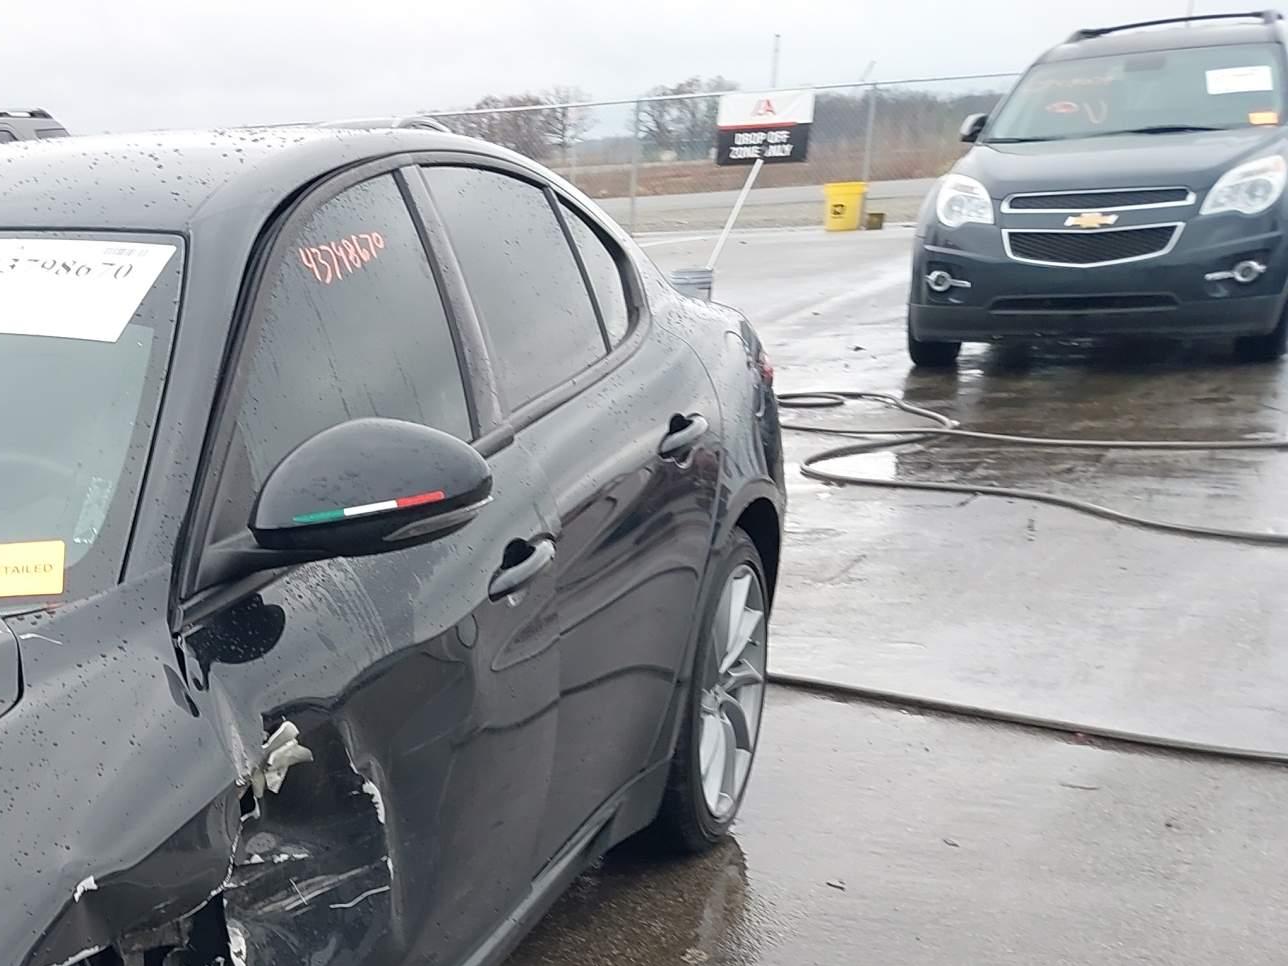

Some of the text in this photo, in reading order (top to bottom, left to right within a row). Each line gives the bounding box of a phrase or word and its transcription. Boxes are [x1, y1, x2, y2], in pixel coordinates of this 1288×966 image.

[734, 130, 791, 145] DROP OFF
[729, 146, 761, 159] ZONE
